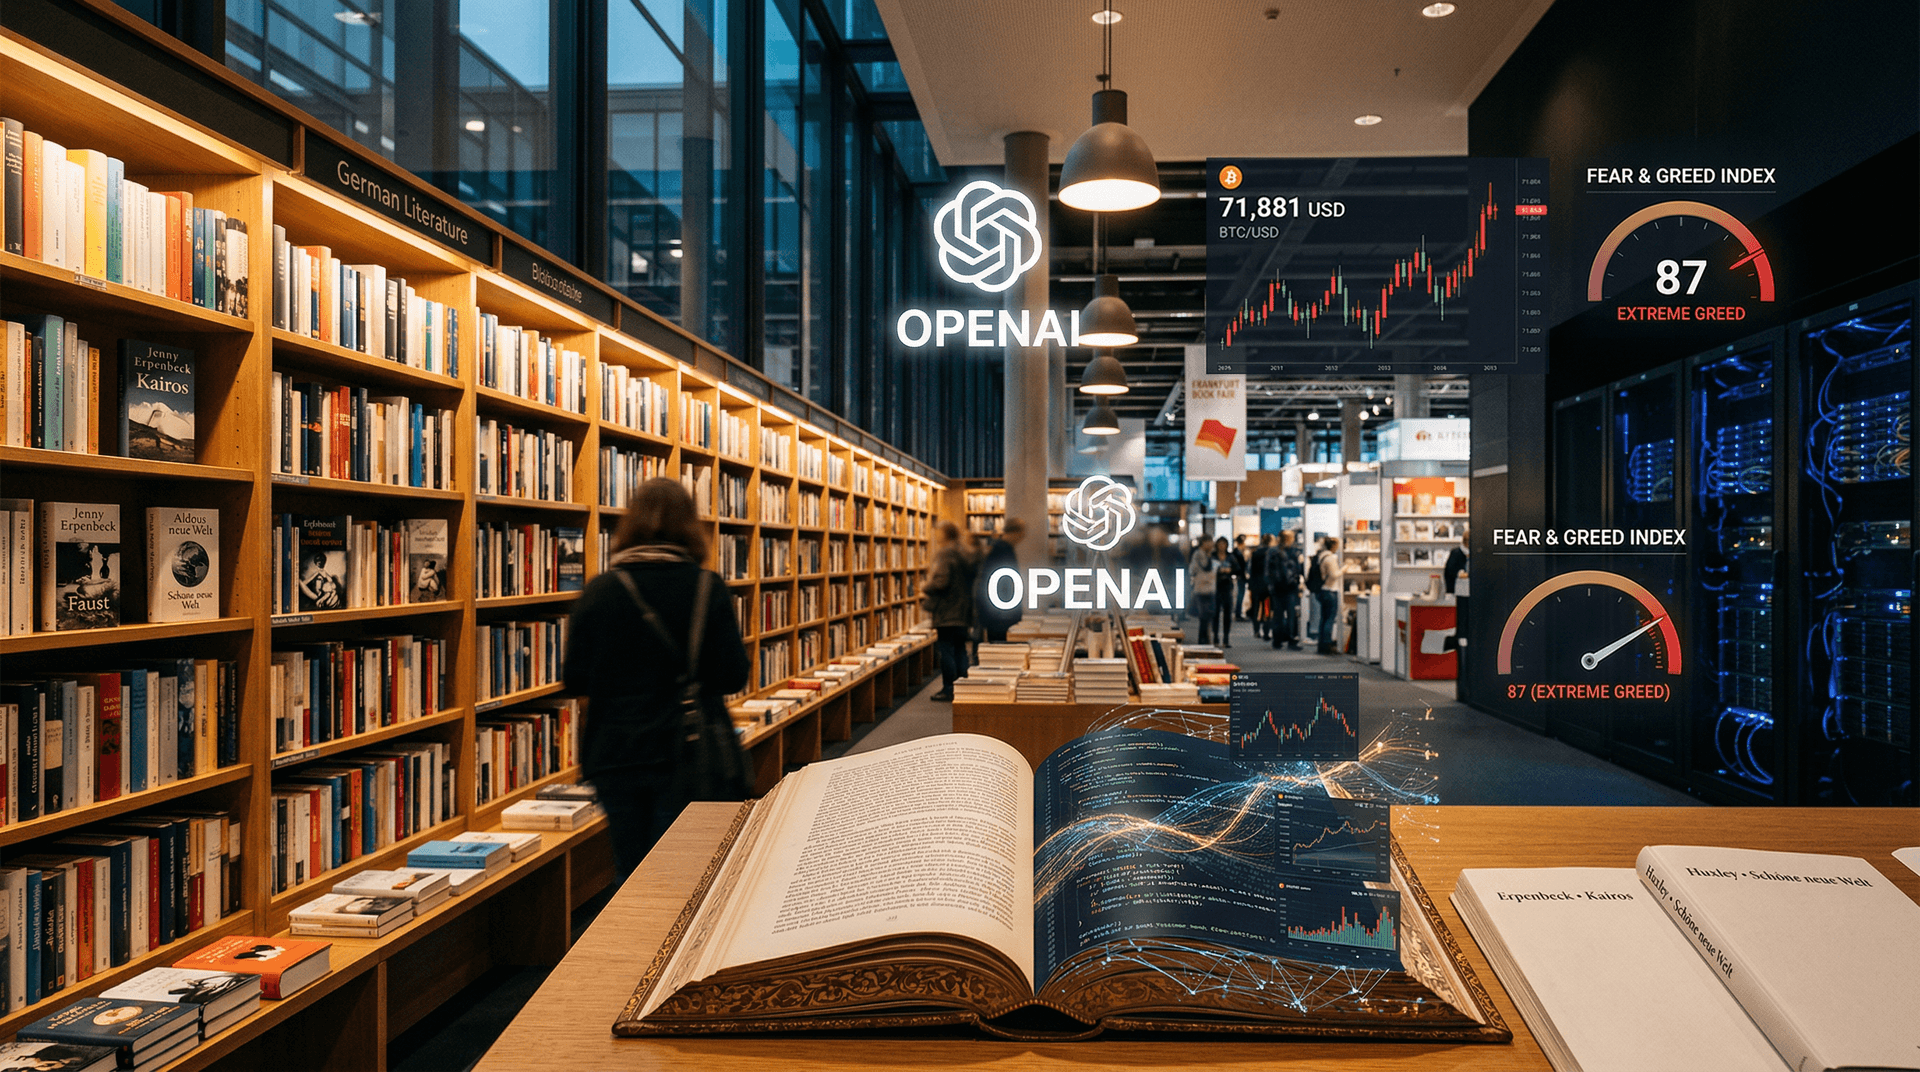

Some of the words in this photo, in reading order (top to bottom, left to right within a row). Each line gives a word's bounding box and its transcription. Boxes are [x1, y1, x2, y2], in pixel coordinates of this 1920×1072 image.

[337, 160, 400, 212] German
[404, 194, 468, 245] Literature
[1219, 196, 1299, 222] 71,881
[1308, 202, 1345, 218] USD
[1219, 226, 1279, 239] BTC/USD
[147, 346, 179, 362] Jenny
[134, 356, 192, 375] Erpenbeck
[136, 372, 189, 395] Kairos
[73, 508, 104, 521] Jenny
[174, 513, 207, 523] Aldous
[61, 520, 116, 533] Erpenbeck
[169, 527, 191, 535] neue
[192, 525, 213, 535] Welt
[68, 595, 110, 612] Faust
[1685, 867, 1738, 880] Huxley
[1803, 875, 1838, 885] neue
[1837, 876, 1874, 888] Welt
[1497, 891, 1575, 903] Erpenbeck
[1584, 891, 1635, 901] Kairos
[1645, 864, 1670, 900] Huxley
[1698, 932, 1716, 957] neue
[1716, 949, 1733, 979] Welt
